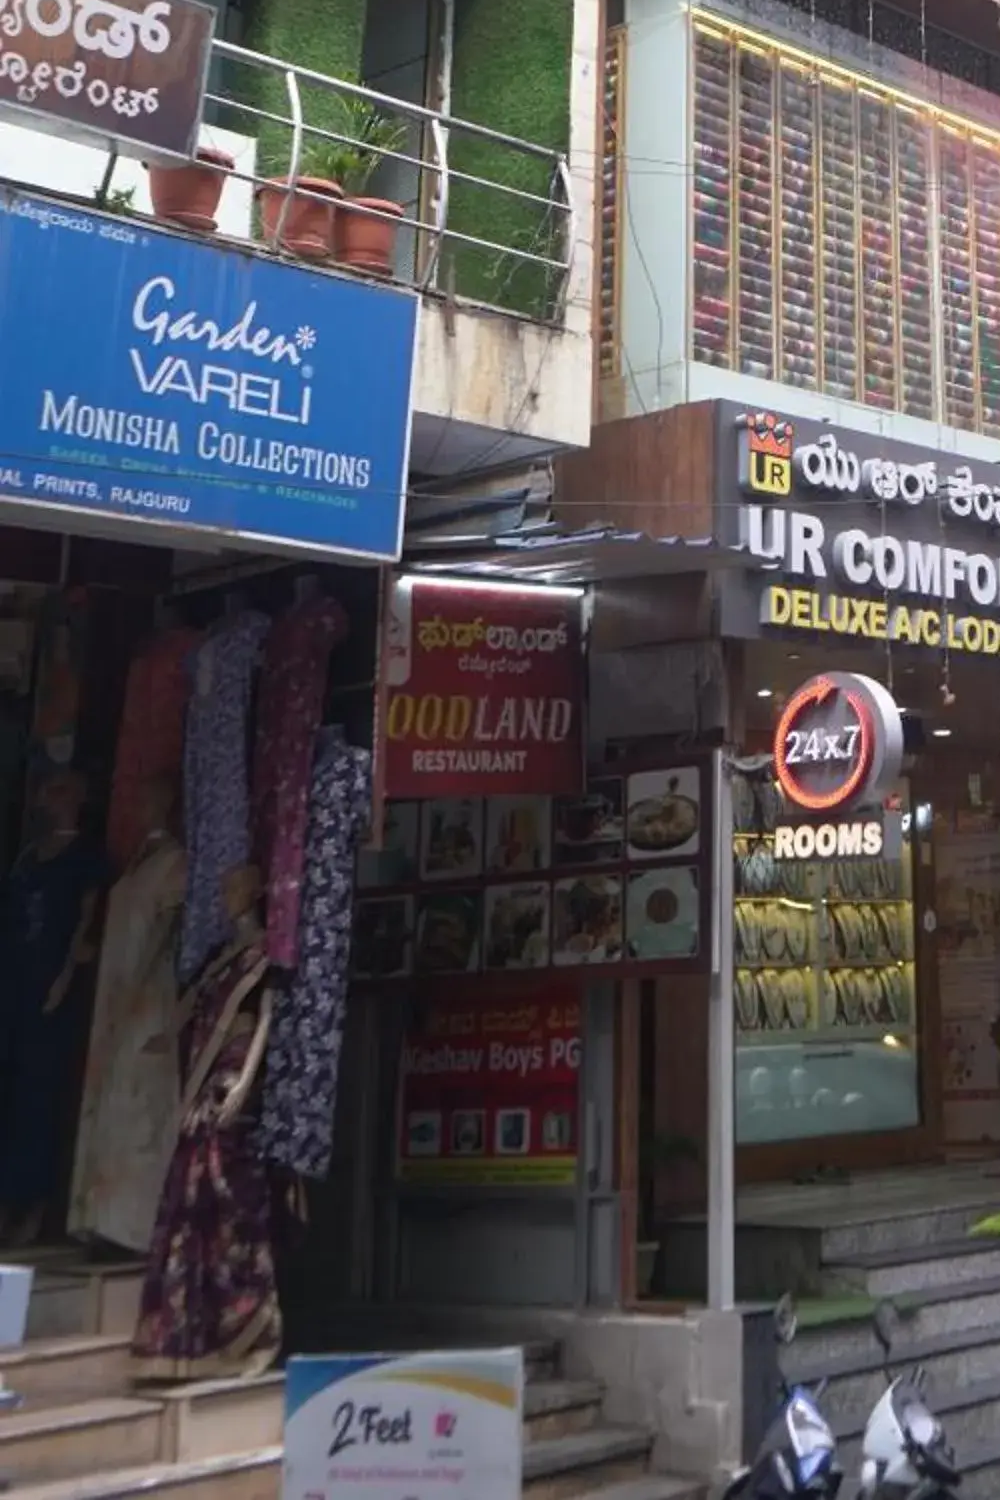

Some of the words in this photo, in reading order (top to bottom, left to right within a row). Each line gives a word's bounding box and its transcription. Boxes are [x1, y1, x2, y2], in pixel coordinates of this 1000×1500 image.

[132, 276, 302, 366] Garden
[39, 390, 181, 456] MONISHA
[198, 422, 371, 489] COLLECTIONS
[754, 451, 786, 488] UR
[867, 458, 938, 505] ಆರ್
[111, 486, 191, 514] RAJGURU
[748, 507, 827, 578] UR
[769, 586, 888, 639] DELUXE
[892, 606, 941, 646] A/C
[411, 748, 529, 774] RESTAURANT
[774, 821, 883, 859] ROOMS
[488, 1039, 544, 1078] Boys
[551, 1036, 582, 1068] PG
[329, 1400, 357, 1460] 2
[360, 1405, 413, 1445] Feet
